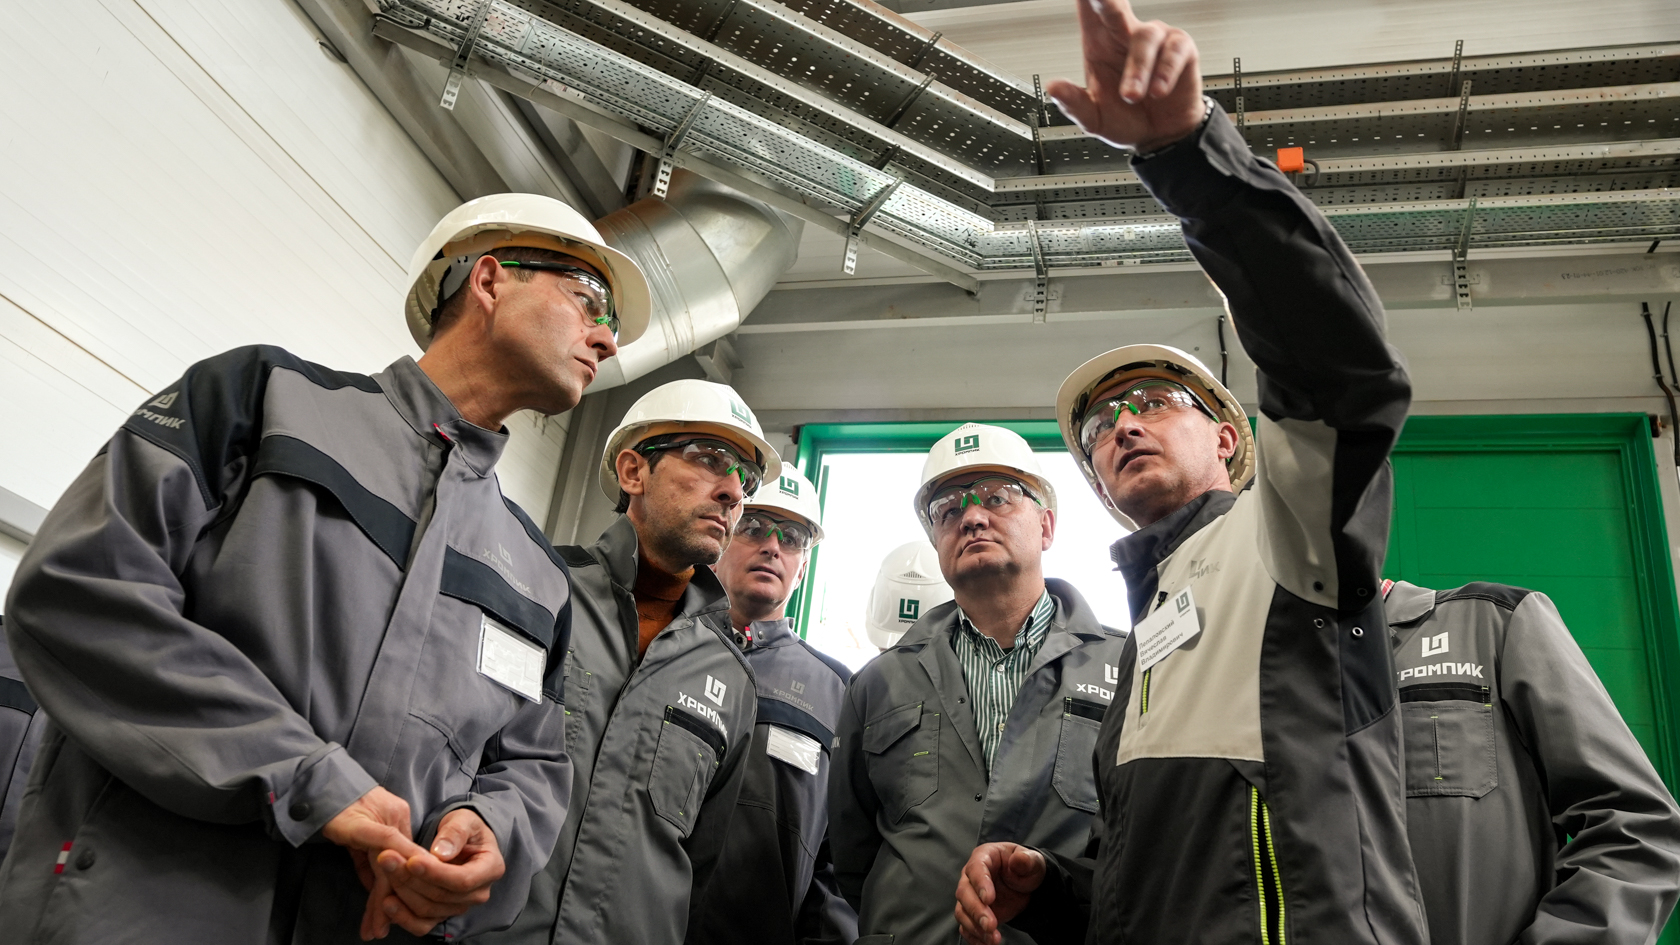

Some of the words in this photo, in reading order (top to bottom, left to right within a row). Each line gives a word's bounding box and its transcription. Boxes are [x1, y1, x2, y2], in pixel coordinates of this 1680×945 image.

[483, 548, 531, 594] ХРОМПИК
[1140, 632, 1184, 665] Владимирович
[1397, 662, 1484, 681] РОМПИК
[773, 687, 814, 711] ХРОМПИК
